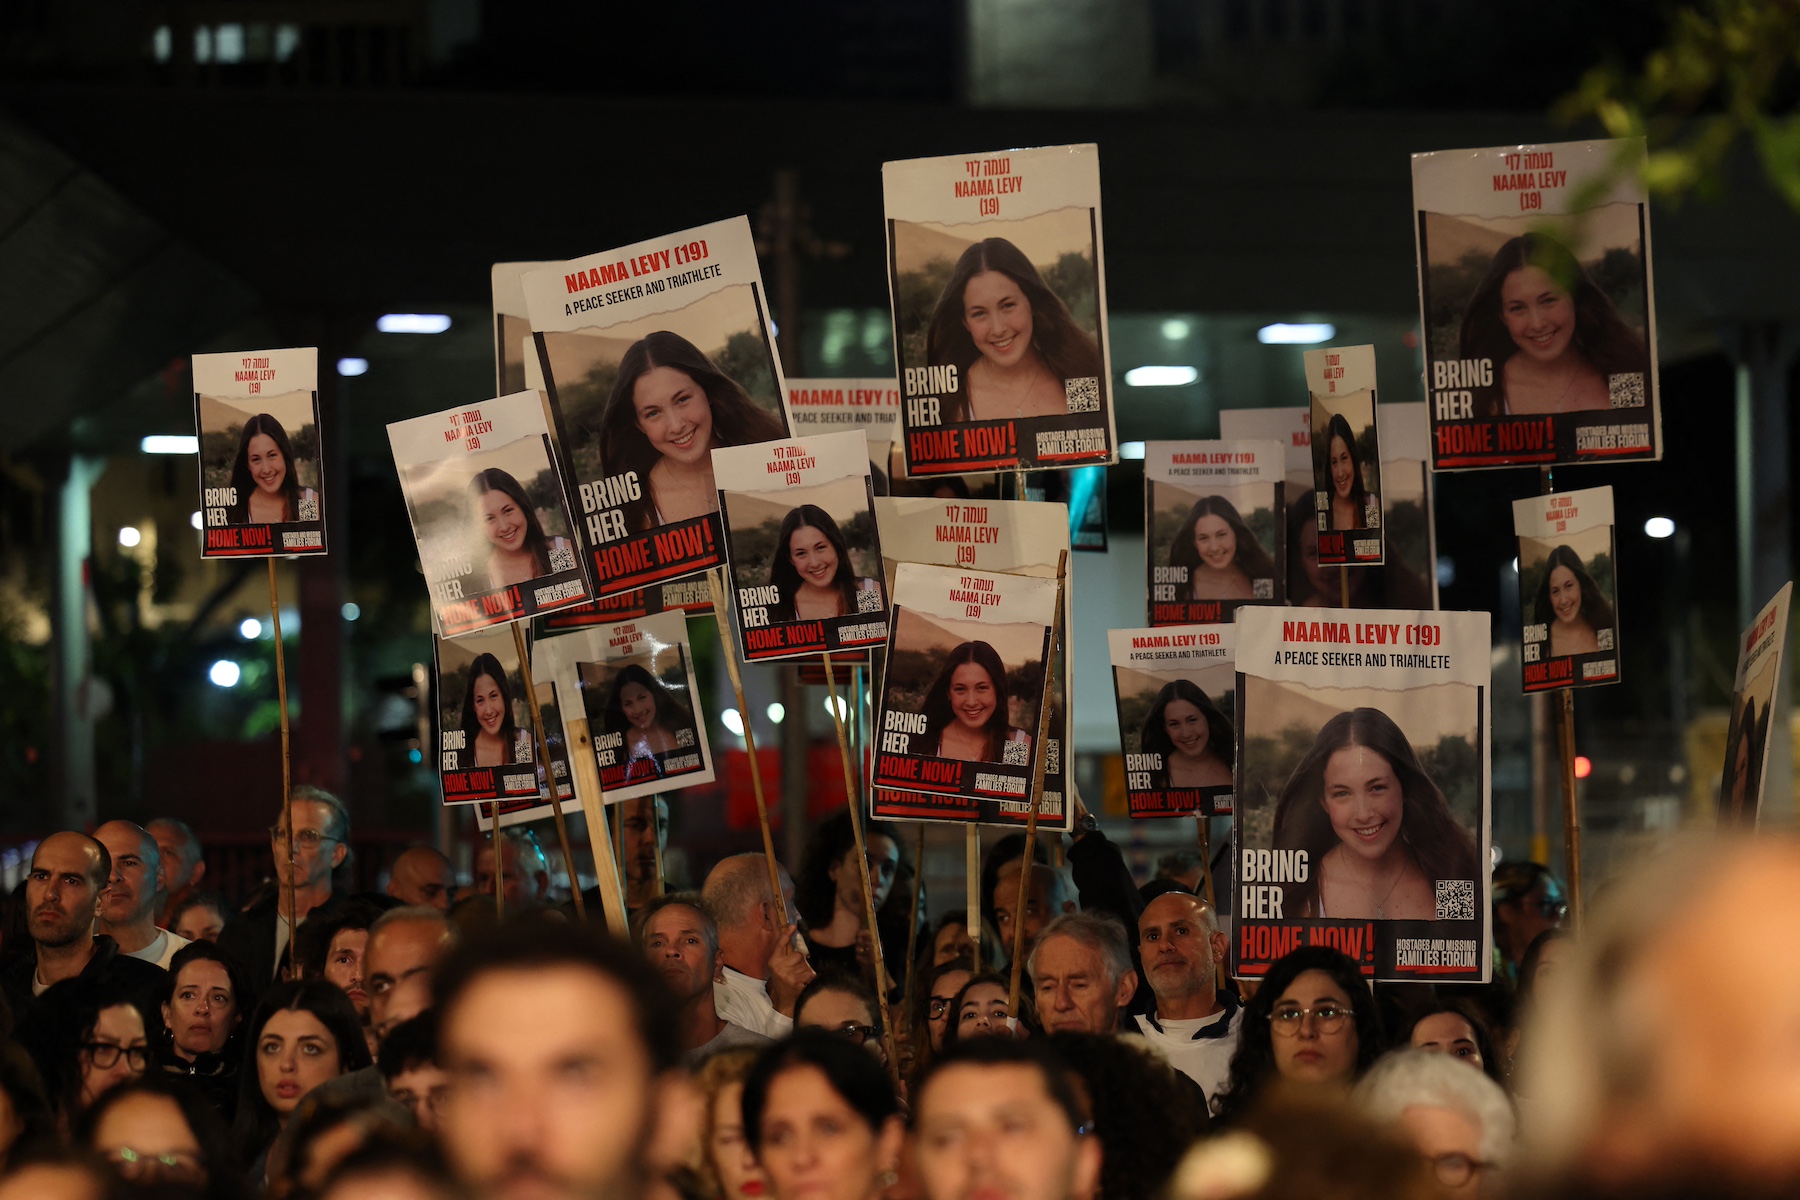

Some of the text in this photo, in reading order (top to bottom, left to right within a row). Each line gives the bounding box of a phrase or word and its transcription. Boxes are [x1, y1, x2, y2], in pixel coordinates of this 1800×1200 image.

[966, 158, 1010, 177] נעמה לוי
[1505, 152, 1553, 171] נעמה לוי
[955, 176, 1022, 198] NAAMA LEVY
[1493, 170, 1567, 192] NAAMA LEVY
[980, 196, 999, 217] (19)
[1520, 191, 1542, 211] (19)
[564, 240, 709, 294] NAAMA LEVY (19)
[565, 263, 722, 316] A PEACE SEEKER AND TRIATHLETE
[235, 369, 276, 381] NAAMA LEVY
[904, 364, 959, 397] BRING
[1433, 358, 1493, 390] BRING
[248, 381, 261, 394] (19)
[789, 389, 883, 406] NAAMA LEVY
[907, 397, 942, 427] HER
[1435, 390, 1473, 421] HER
[474, 420, 493, 435] LEVY
[792, 413, 872, 424] PEACE SEEKER AND
[465, 436, 480, 451] (19)
[910, 421, 1017, 461] HOME NOW!
[1066, 430, 1078, 440] AND
[1437, 424, 1493, 455] HOME
[1497, 416, 1555, 453] NOW!
[1577, 433, 1649, 450] FAMILIES FORUM
[1037, 438, 1106, 456] FAMILIES FORUM
[767, 457, 816, 474] NAAMA LEVY
[1172, 453, 1255, 464] NAAMA LEVY (19)
[786, 472, 801, 486] (19)
[1173, 468, 1191, 476] PEACE
[1192, 468, 1214, 476] SEEKER
[1214, 467, 1226, 476] AND
[205, 487, 237, 507] BRING
[578, 470, 642, 514] BRING
[206, 507, 228, 526] HER
[946, 505, 988, 524] נעמה לוי
[207, 525, 273, 548] HOME NOW!
[585, 509, 629, 546] HER
[936, 525, 999, 544] NAAMA LEVY
[594, 518, 715, 580] HOME NOW!
[957, 545, 976, 565] (19)
[960, 576, 994, 592] נעמה לוי
[1153, 566, 1188, 583] BRING
[739, 584, 780, 608] BRING
[949, 589, 1002, 607] NAAMA LEVY
[1154, 584, 1176, 602] HER
[441, 599, 481, 626] HOME
[481, 585, 523, 616] NOW!
[965, 605, 981, 619] (19)
[1153, 601, 1222, 621] HOME NOW!
[742, 606, 770, 628] HER
[609, 632, 643, 647] NAAMA LEVY
[745, 627, 785, 650] HOME
[785, 621, 825, 645] NOW!
[1132, 633, 1220, 649] NAAMA LEVY (19)
[1283, 621, 1441, 646] NAAMA LEVY (19)
[1523, 623, 1547, 644] BRING
[1135, 652, 1154, 660] PEACE
[1154, 651, 1177, 659] SEEKER
[1178, 650, 1190, 658] AND
[1191, 648, 1227, 658] TRIATHLETE
[1274, 651, 1450, 669] A PEACE SEEKER AND TRIATHLETE
[1524, 643, 1541, 663] HER
[1525, 663, 1548, 683] HOME
[1549, 656, 1573, 679] NOW!
[885, 709, 928, 735] BRING
[443, 730, 466, 751] BRING
[594, 731, 623, 751] BRING
[881, 732, 910, 755] HER
[442, 751, 459, 771] HER
[596, 750, 616, 767] HER
[1126, 753, 1162, 772] BRING
[600, 765, 626, 784] HOME
[879, 755, 919, 778] HOME
[921, 761, 962, 785] NOW!
[444, 773, 469, 793] HOME
[469, 768, 495, 793] NOW!
[975, 780, 1026, 795] FAMILIES FORUM
[1128, 772, 1152, 790] HER
[1000, 801, 1031, 813] FAMILIE
[1129, 789, 1200, 811] HOME NOW!
[1241, 848, 1309, 883] BRING
[1241, 885, 1284, 919] HER
[1241, 925, 1303, 960] HOME
[1396, 938, 1476, 952] HOSTAGES AND MISSING
[1396, 950, 1477, 967] FAMILIES FORUM
